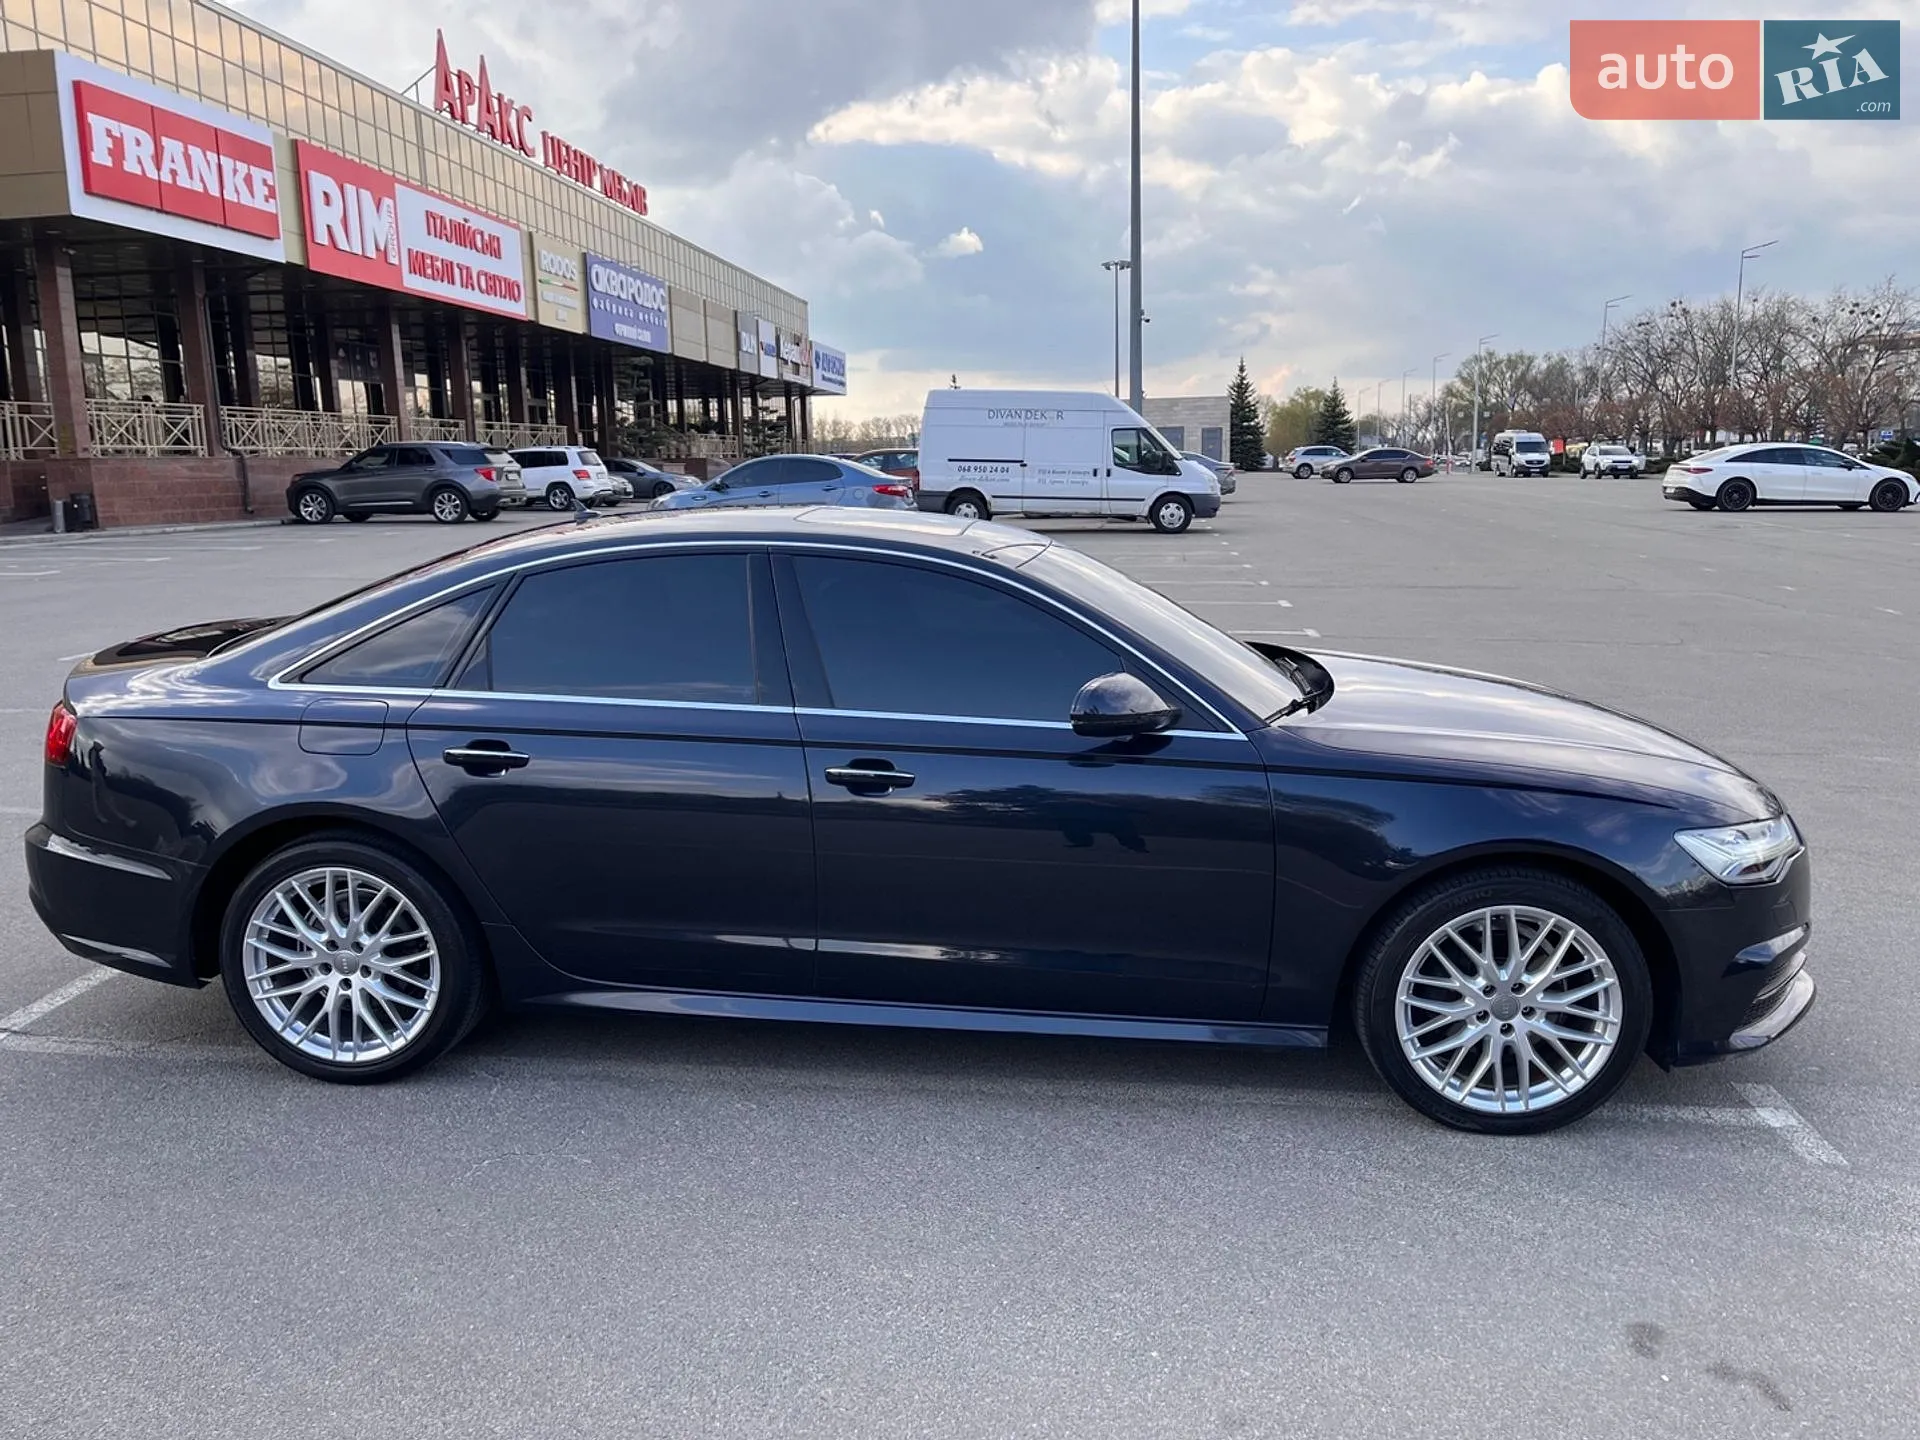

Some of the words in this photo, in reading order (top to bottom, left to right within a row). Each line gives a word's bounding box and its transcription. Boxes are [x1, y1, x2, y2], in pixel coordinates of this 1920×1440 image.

[87, 112, 277, 214] FRANKE
[541, 130, 598, 188] ЦЕНТР
[308, 170, 399, 265] RIM
[425, 209, 502, 260] ІТАЛІЙСЬКІ
[408, 248, 455, 286] МЕБЛІ
[457, 263, 475, 292] ТА
[477, 270, 522, 303] СВІТЛО
[540, 249, 577, 280] RODOS
[988, 409, 1022, 420] DIVAN
[1024, 409, 1065, 421] DEKR
[957, 465, 971, 473] 068
